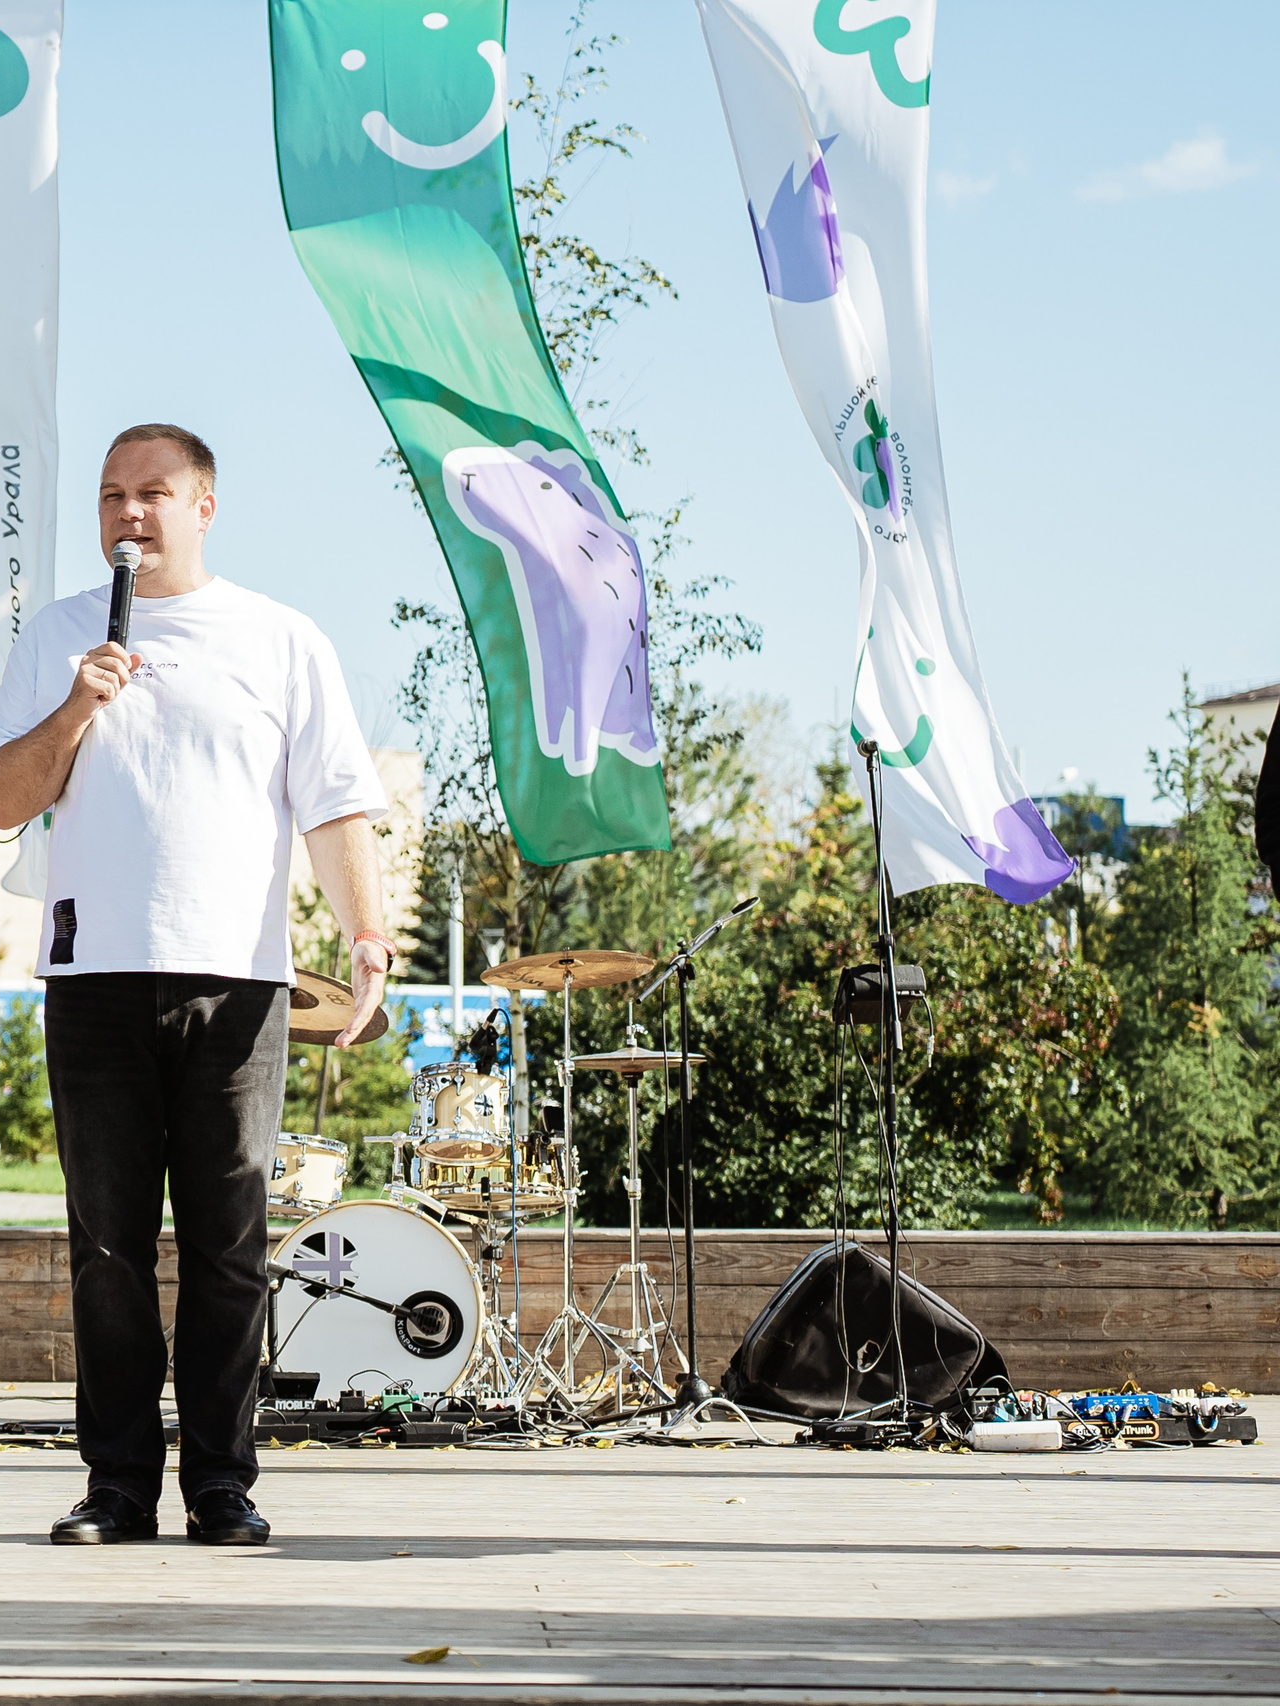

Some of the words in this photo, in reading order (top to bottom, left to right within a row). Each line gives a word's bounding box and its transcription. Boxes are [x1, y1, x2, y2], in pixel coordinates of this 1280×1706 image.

[0, 444, 24, 539] Урала
[8, 556, 22, 643] ного
[396, 1319, 421, 1354] KickPort
[275, 1400, 317, 1411] MORLEY
[1101, 1424, 1154, 1436] ToTrunk
